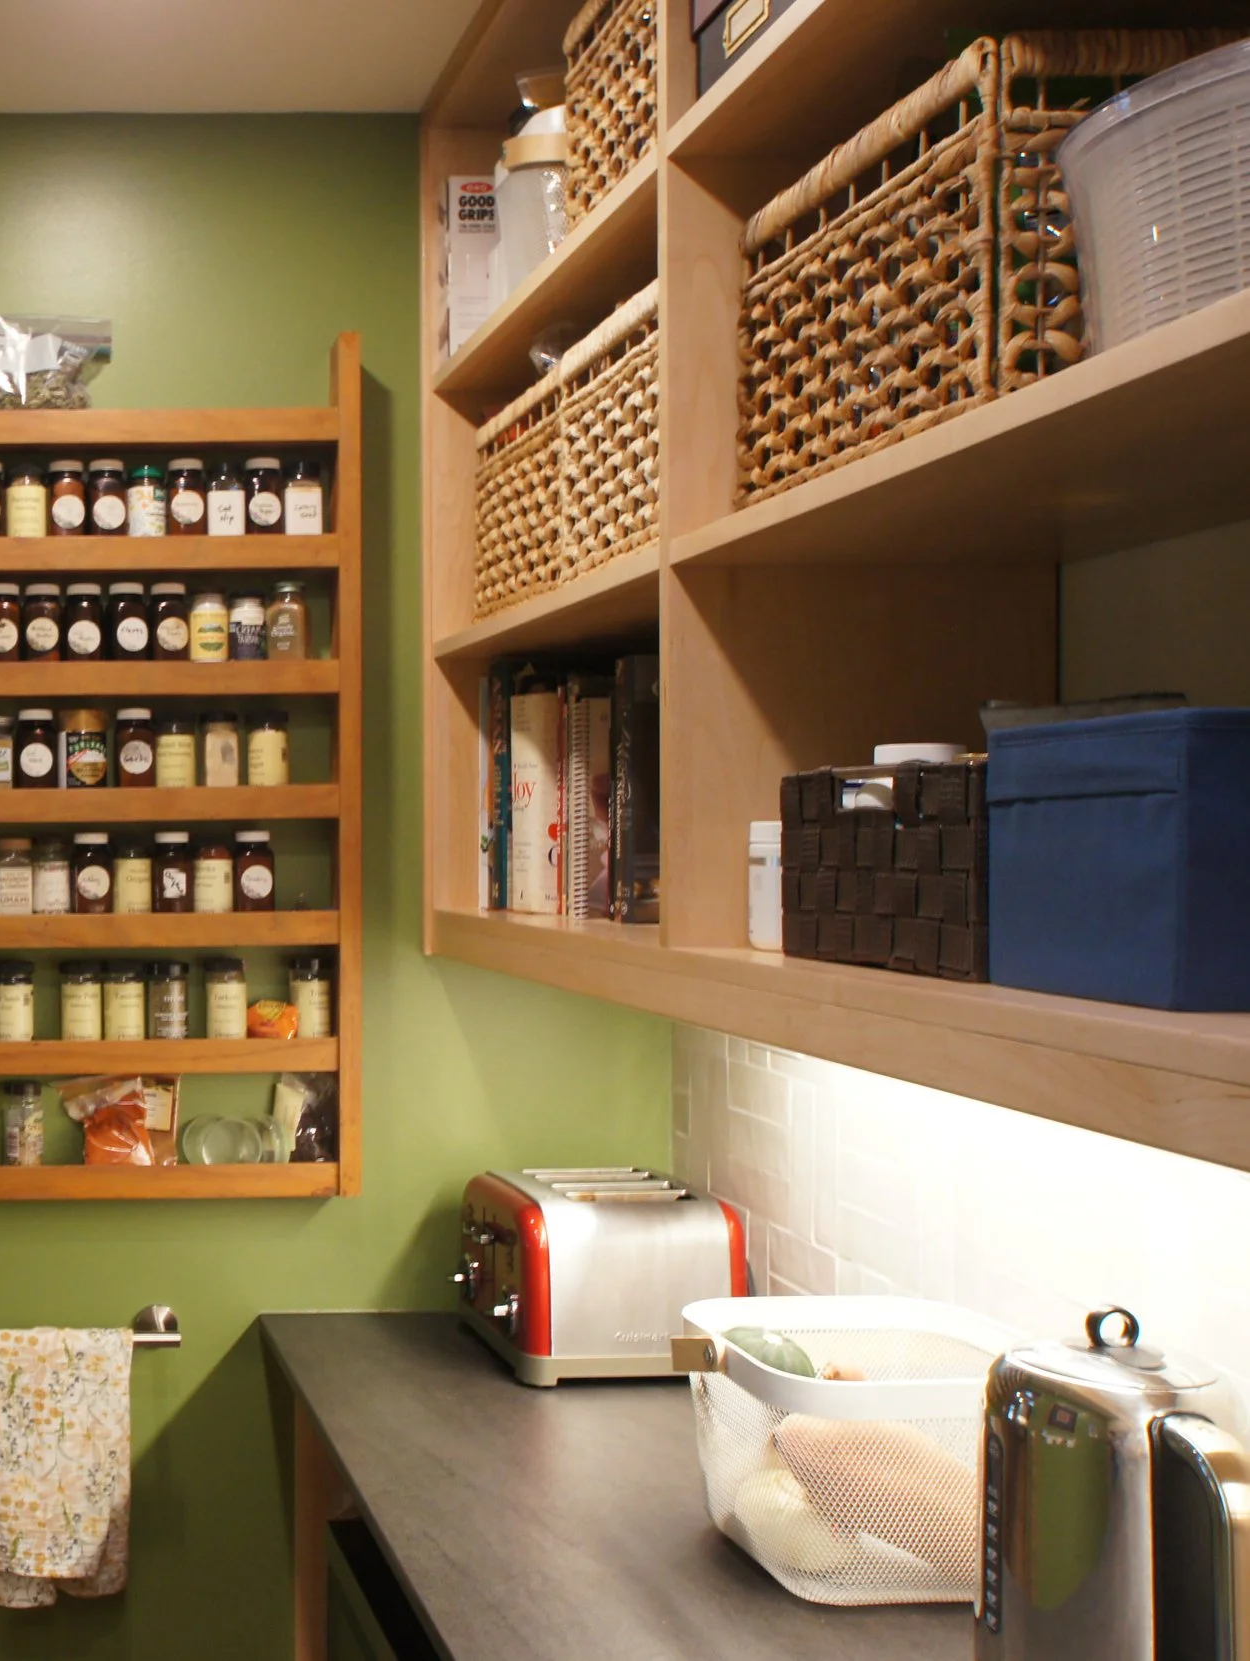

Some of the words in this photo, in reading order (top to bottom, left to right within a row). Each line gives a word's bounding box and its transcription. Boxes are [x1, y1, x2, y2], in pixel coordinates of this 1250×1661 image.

[459, 195, 495, 208] GOOD
[459, 208, 495, 221] GRIPS
[513, 770, 537, 809] Joy
